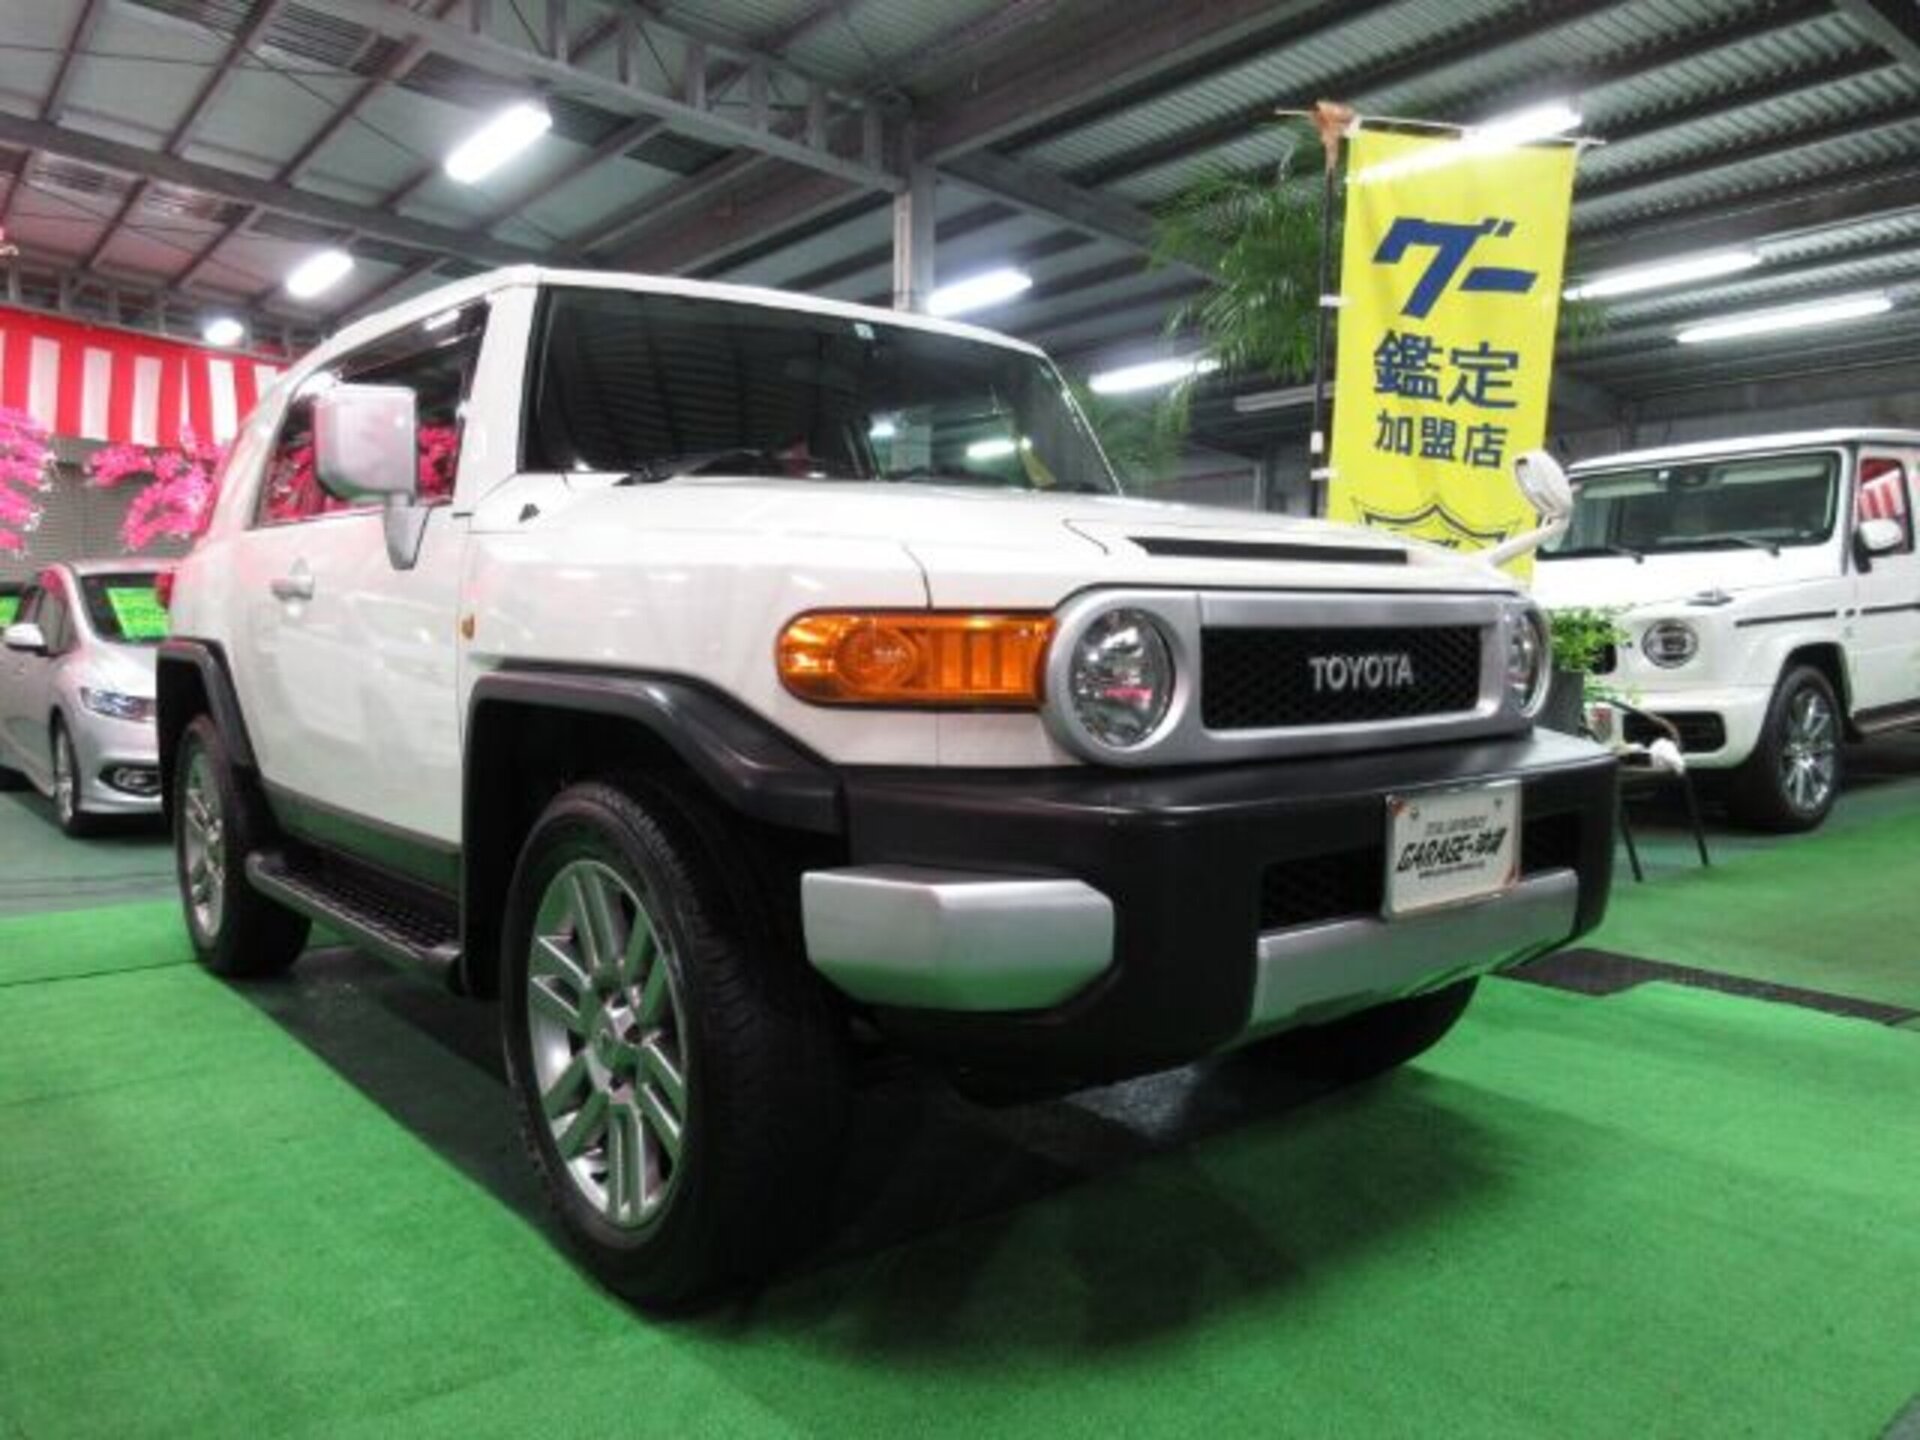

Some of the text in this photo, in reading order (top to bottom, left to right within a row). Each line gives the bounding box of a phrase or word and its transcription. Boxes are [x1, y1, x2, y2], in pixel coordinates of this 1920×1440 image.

[1373, 216, 1538, 318] グー
[1373, 330, 1519, 409] 鑑定
[1375, 409, 1508, 469] 加盟店
[1309, 654, 1415, 692] TOYOTA
